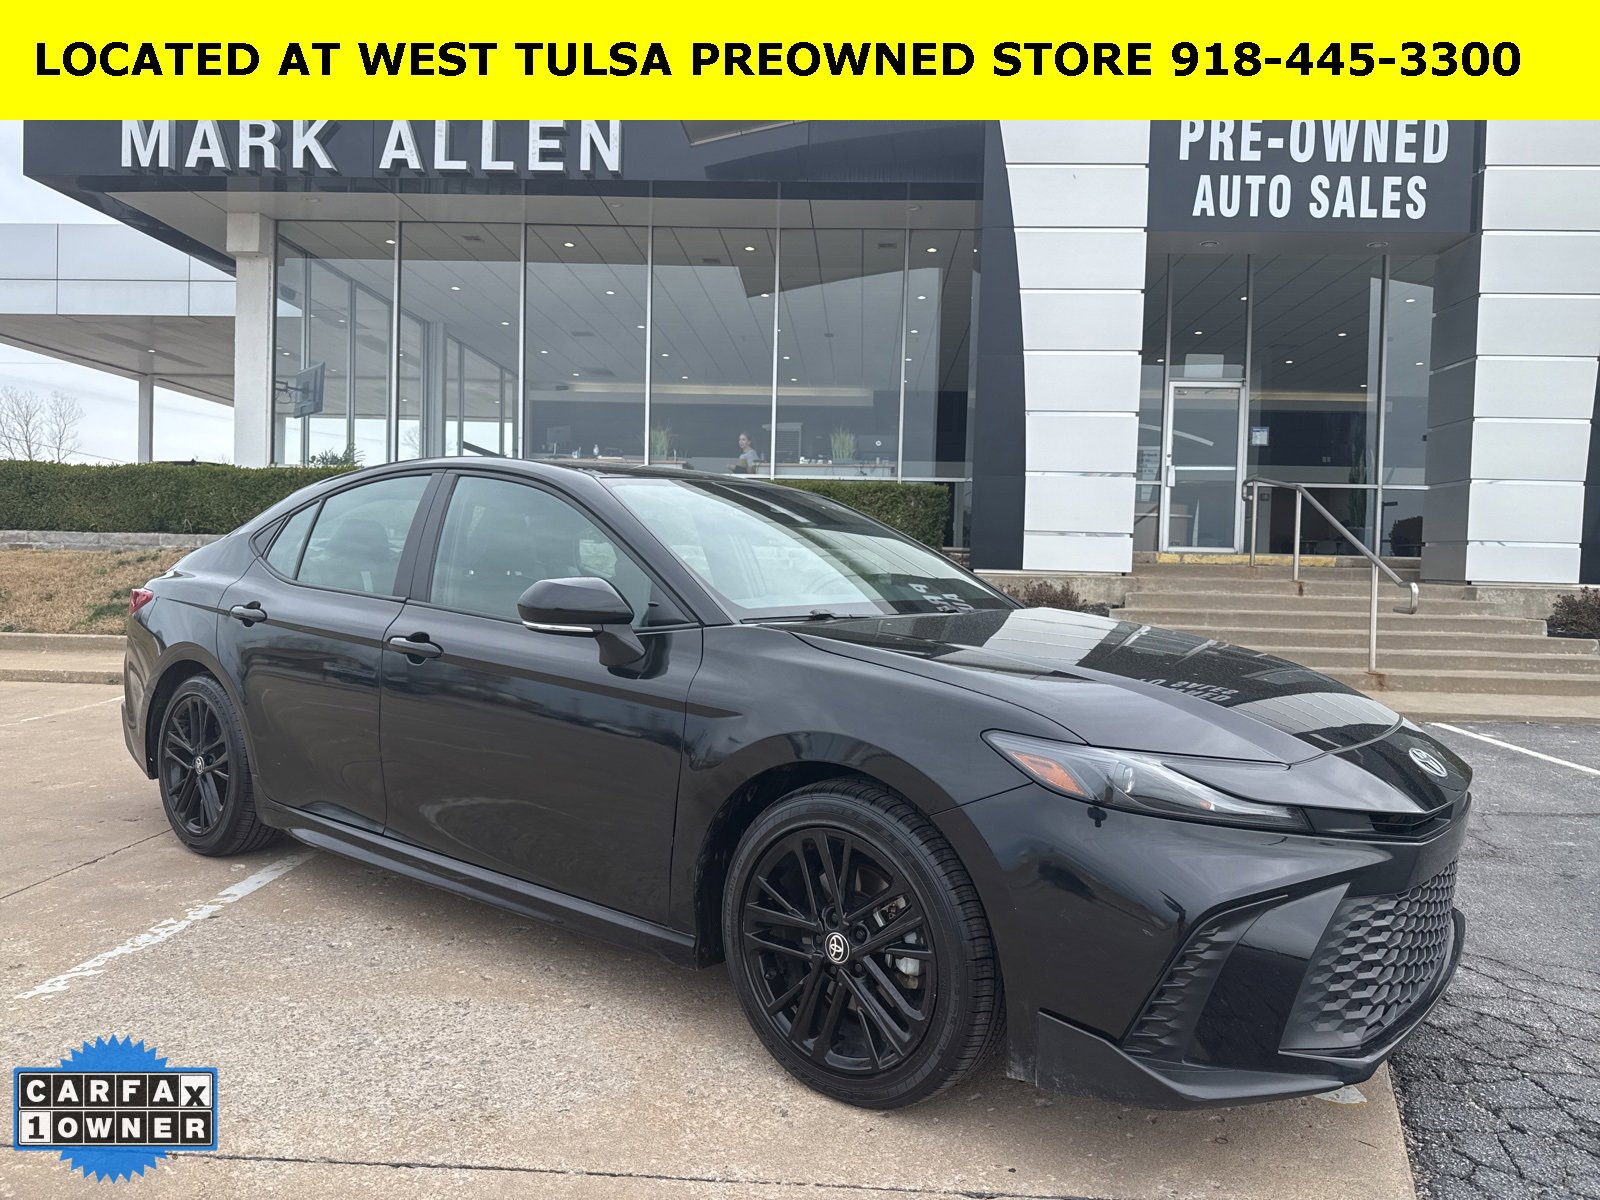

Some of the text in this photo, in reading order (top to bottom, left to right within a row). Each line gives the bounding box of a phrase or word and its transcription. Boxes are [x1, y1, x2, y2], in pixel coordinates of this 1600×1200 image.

[121, 120, 621, 172] MARK ALLEN
[1179, 120, 1449, 164] PRE-OWNED
[1192, 174, 1427, 220] AUTO SALES
